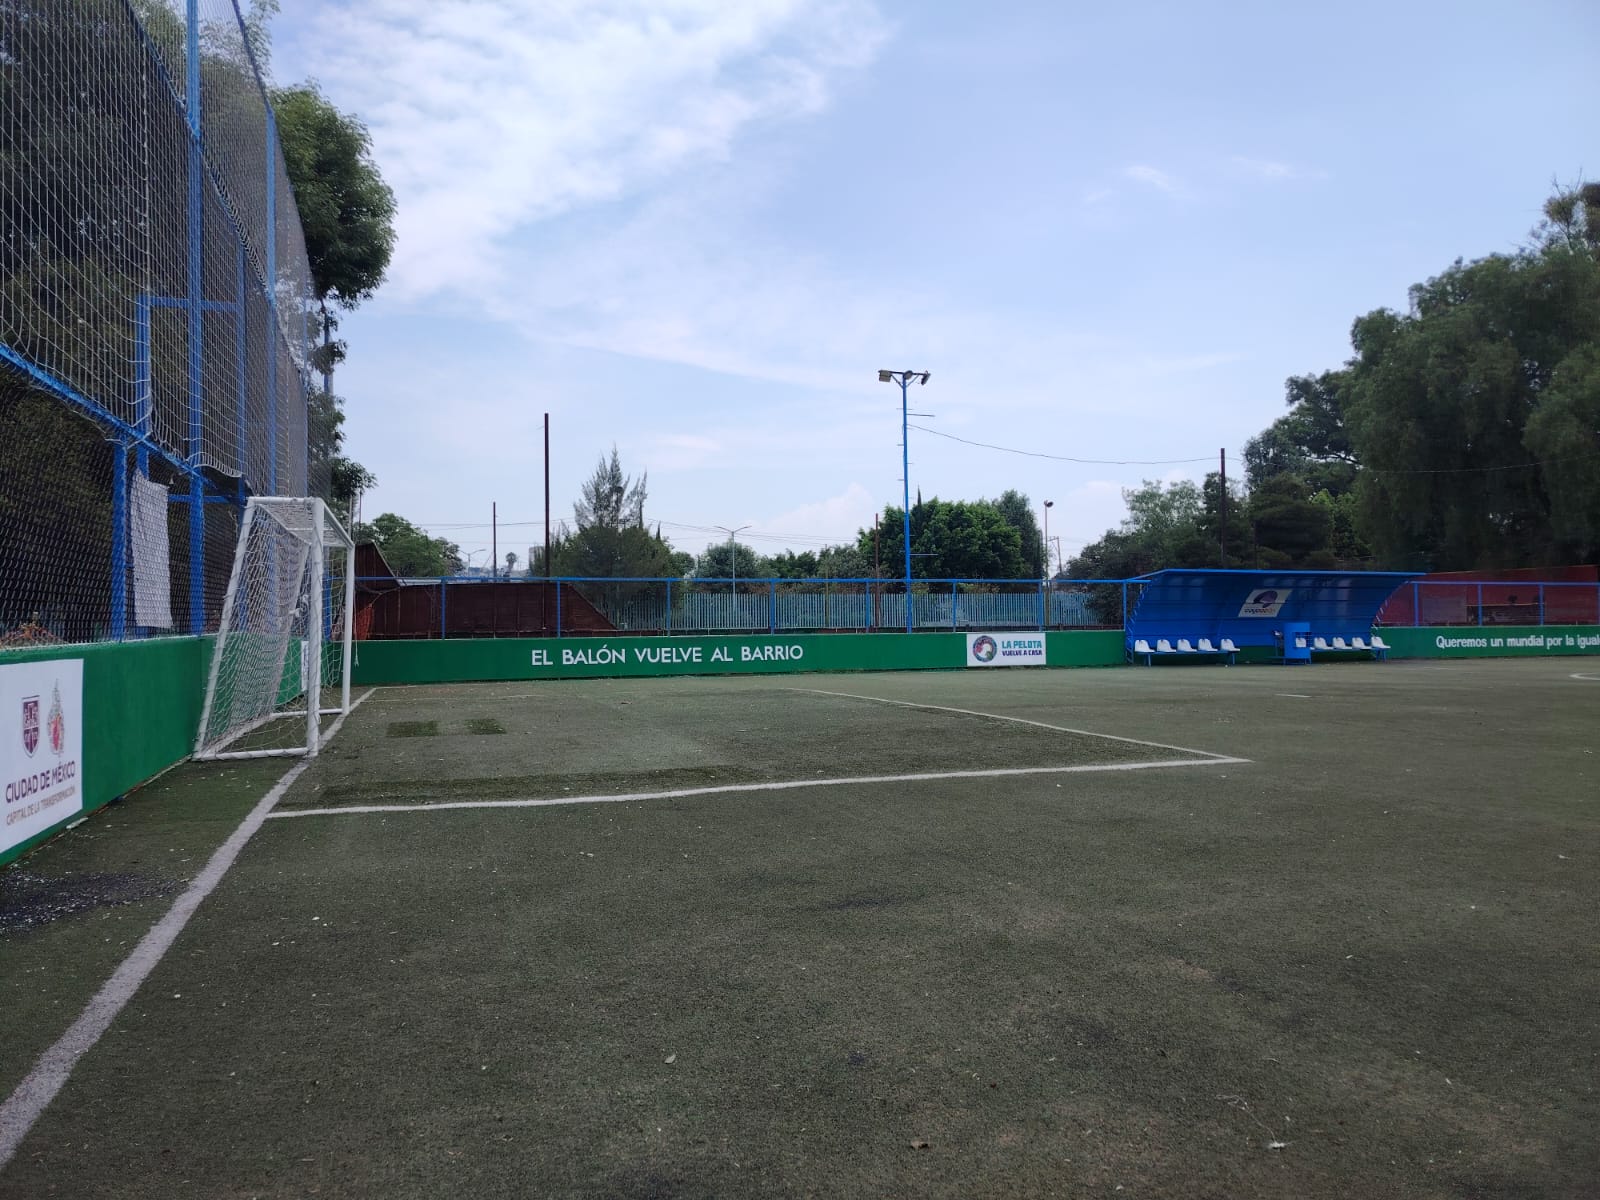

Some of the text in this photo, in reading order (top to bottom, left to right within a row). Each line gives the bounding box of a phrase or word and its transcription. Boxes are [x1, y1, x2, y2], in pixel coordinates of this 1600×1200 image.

[1002, 640, 1042, 648] LA PELOTA
[1436, 634, 1600, 650] Queremos un mundial por la igual
[531, 644, 804, 666] EL BALÓN VUELVE AL BARRIO
[6, 761, 76, 803] CIUDAD DE MÉXICO
